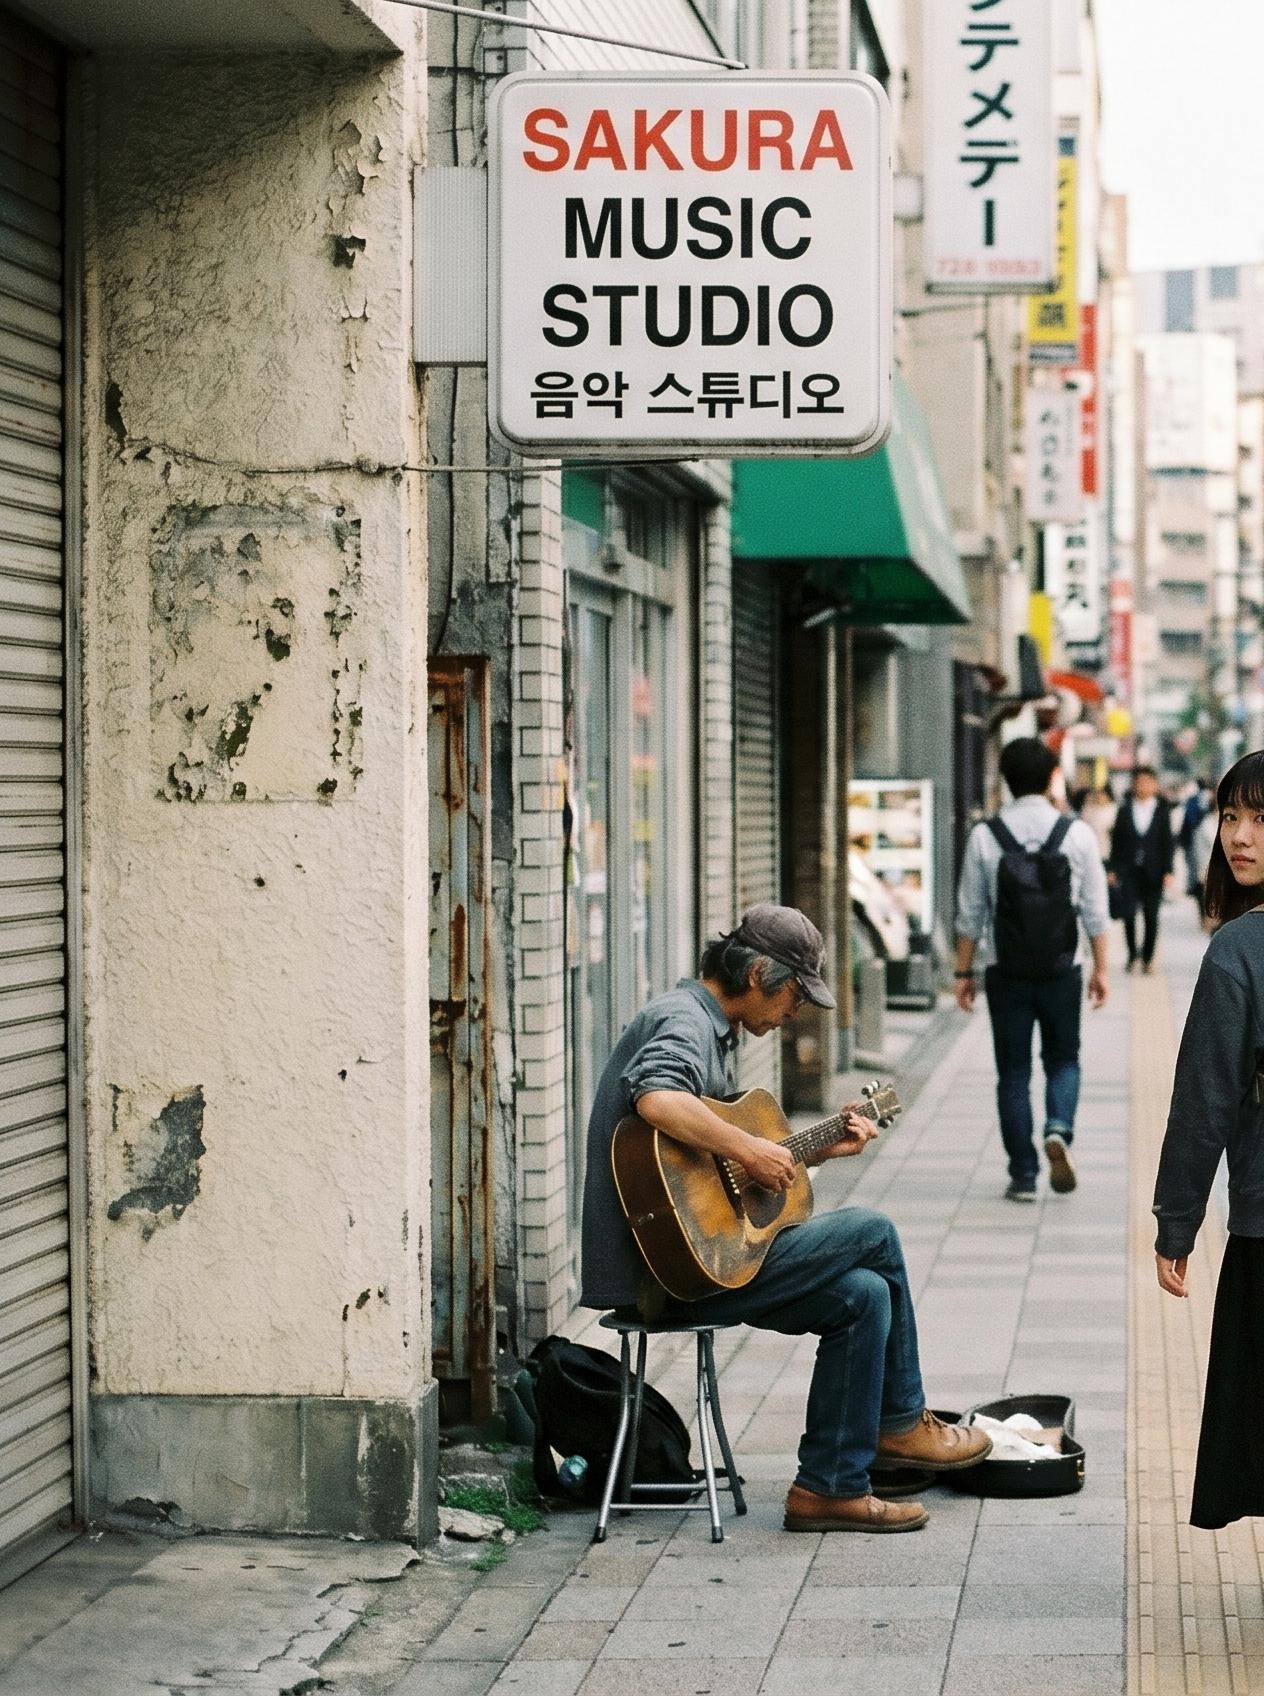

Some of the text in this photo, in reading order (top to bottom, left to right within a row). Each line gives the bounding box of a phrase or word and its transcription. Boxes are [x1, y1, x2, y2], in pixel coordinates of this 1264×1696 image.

[523, 108, 853, 172] SAKURA
[565, 197, 811, 260] MUSIC
[542, 284, 833, 347] STUDIO
[531, 371, 844, 418] 음악 스튜디오
